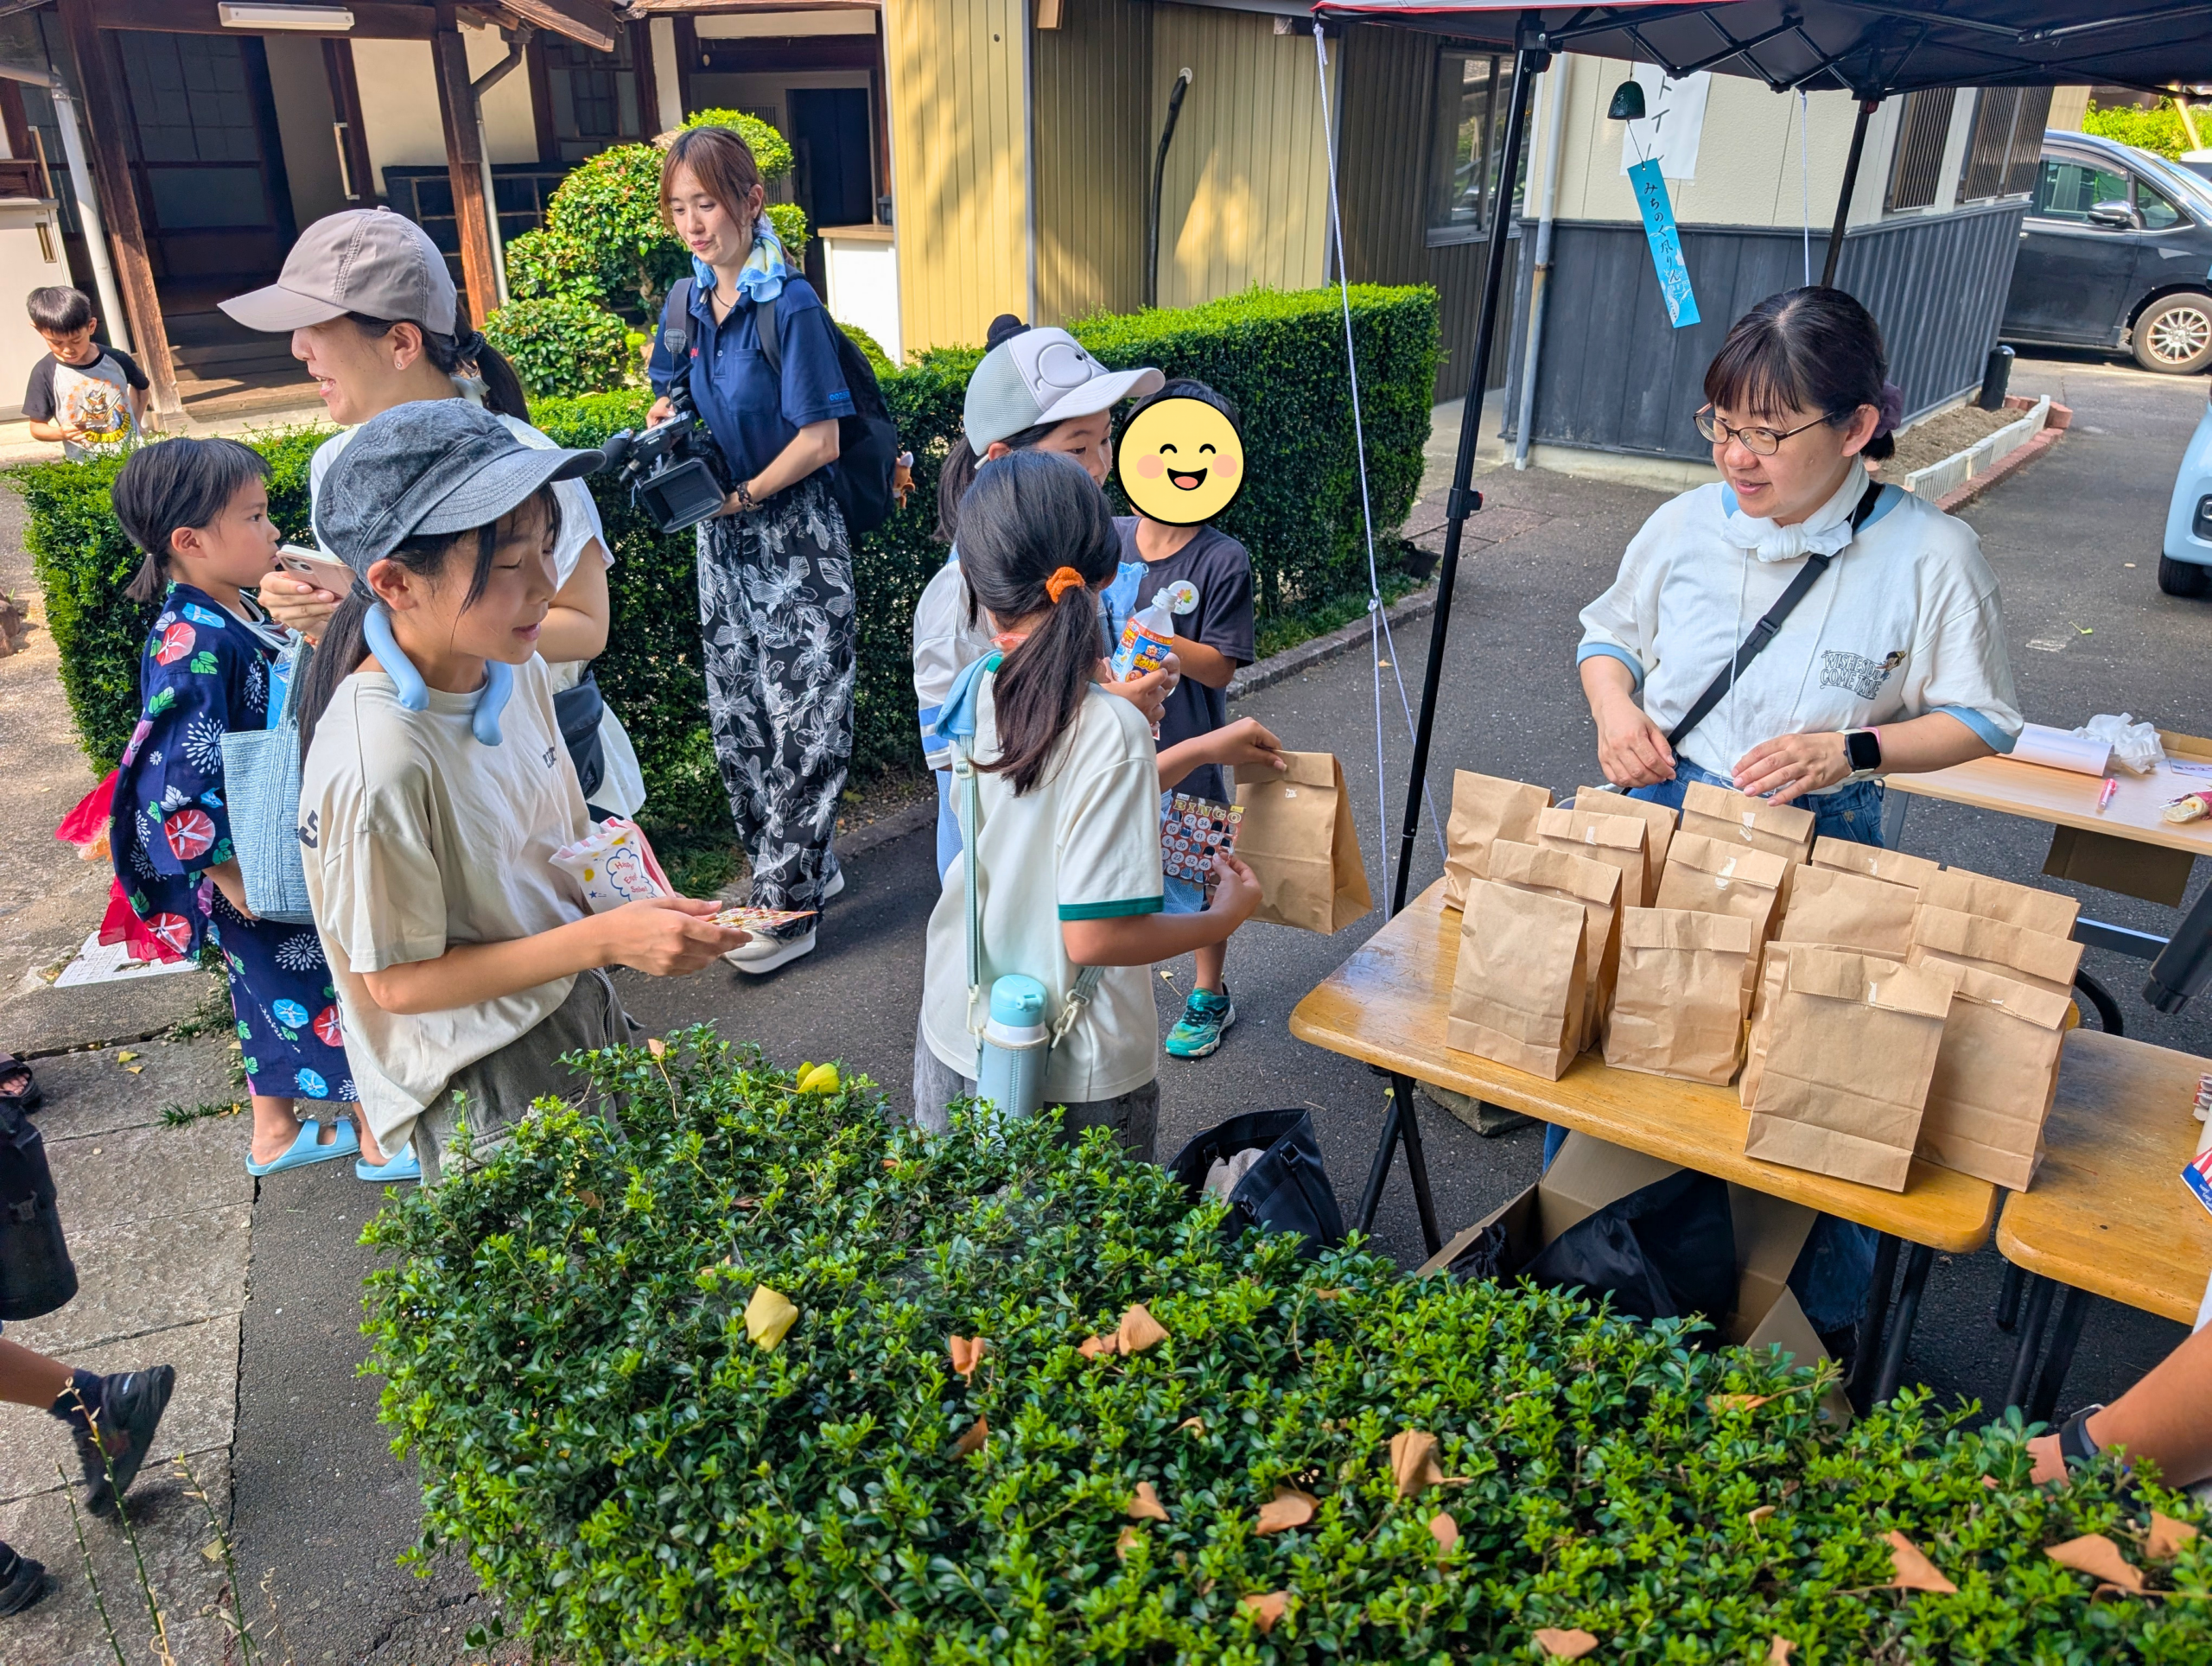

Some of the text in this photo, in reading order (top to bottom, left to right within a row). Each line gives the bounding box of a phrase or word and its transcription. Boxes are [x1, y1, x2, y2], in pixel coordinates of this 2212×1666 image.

[1821, 653, 1881, 680] WISHES DO
[1820, 668, 1856, 688] COME
[1855, 675, 1881, 697] TRUE
[1173, 800, 1242, 823] BINGO
